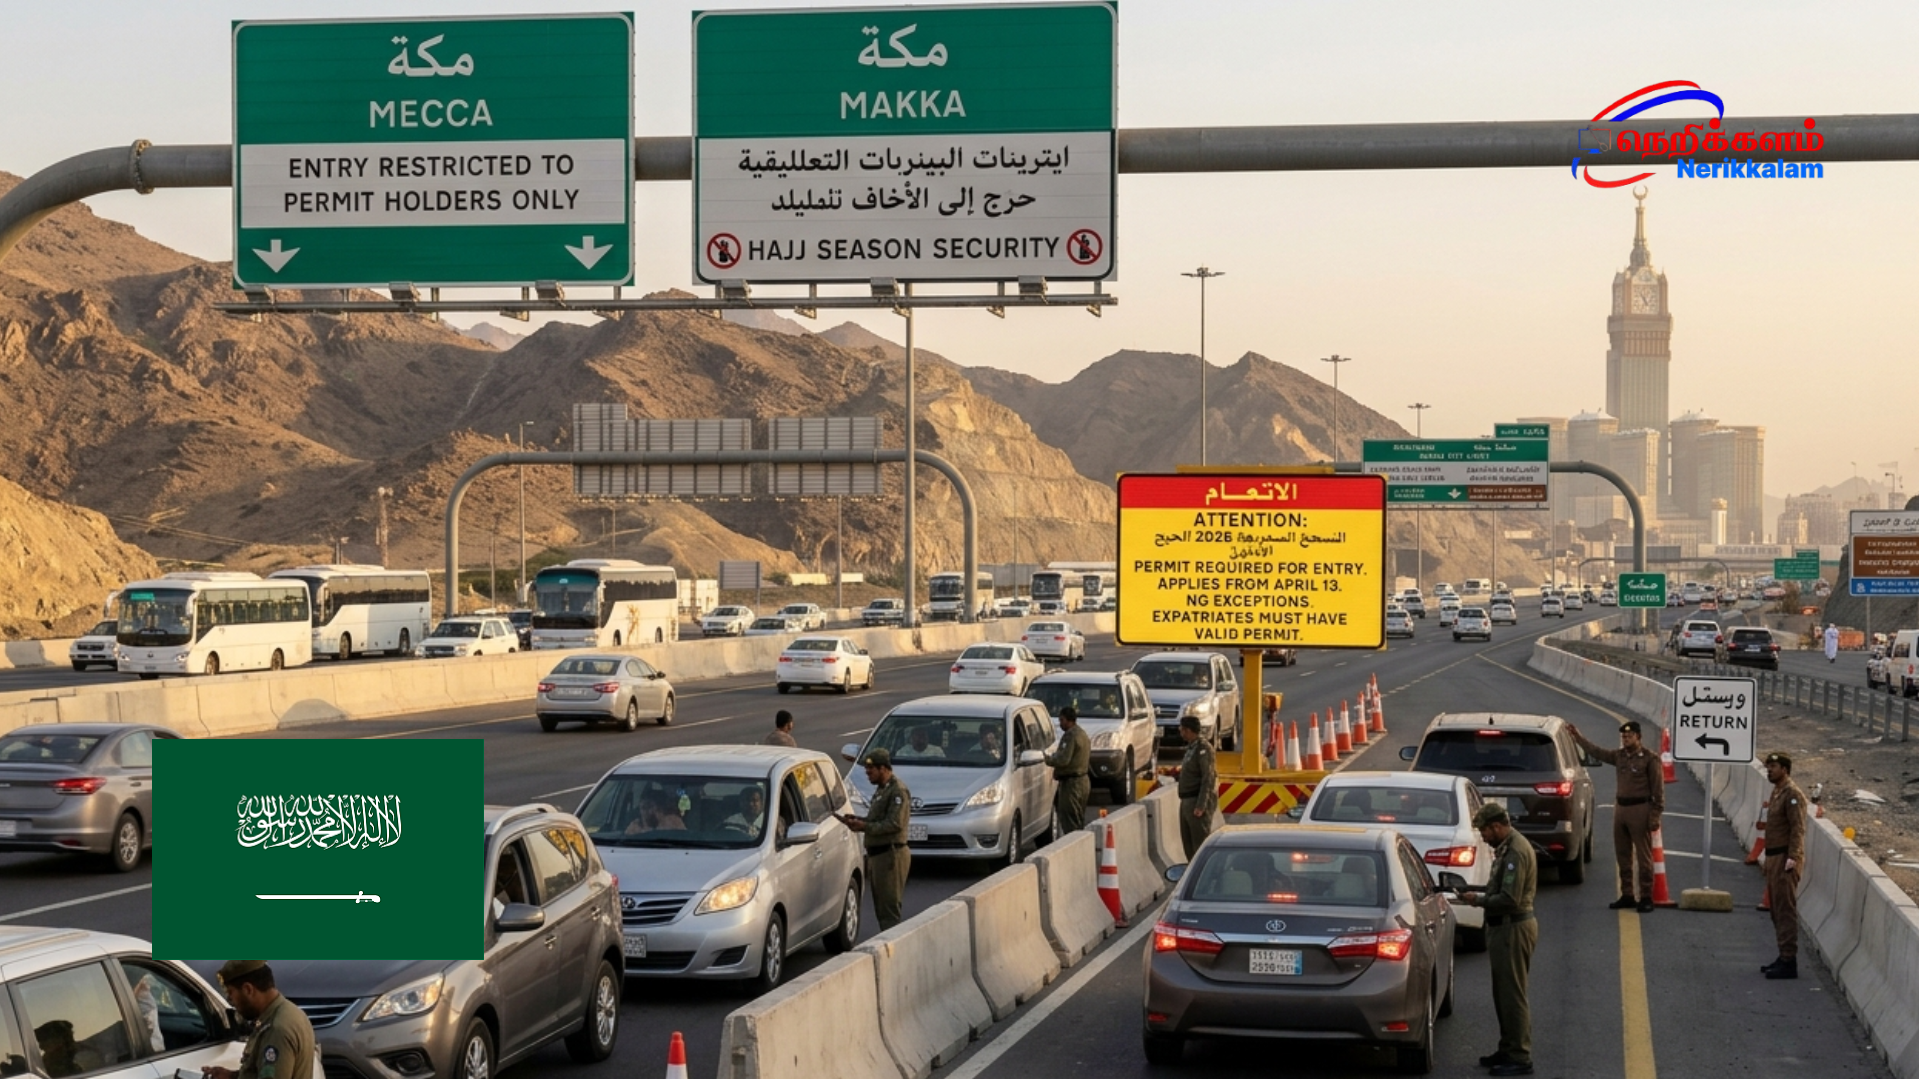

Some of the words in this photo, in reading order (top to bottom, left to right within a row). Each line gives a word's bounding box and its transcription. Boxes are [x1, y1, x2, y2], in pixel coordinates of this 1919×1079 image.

[387, 33, 474, 77] مكة
[857, 23, 948, 68] مكة
[369, 99, 493, 128] MECCA
[840, 89, 966, 119] MAKKA
[289, 157, 369, 178] ENTRY
[379, 155, 532, 177] RESTRICTED
[541, 154, 574, 175] TO
[284, 191, 374, 213] PERMIT
[385, 189, 501, 212] HOLDERS
[512, 188, 579, 210] ONLY
[938, 186, 974, 216] إلى
[983, 192, 1037, 218] حرج
[748, 239, 806, 261] HAJJ
[817, 238, 921, 261] SEASON
[933, 236, 1060, 259] SECURITY
[1193, 512, 1308, 527] ATTENTION:
[1134, 560, 1191, 573] PERMIT
[1278, 562, 1308, 575] FOR
[1313, 563, 1367, 576] ENTRY.
[1157, 577, 1221, 590] APPLIES
[1273, 579, 1318, 591] APRIL
[1322, 580, 1342, 592] 13.
[1152, 610, 1254, 624] EXPATRIATES
[1259, 612, 1303, 624] MUST
[1306, 613, 1348, 626] HAVE
[1194, 627, 1239, 640] VALID
[1679, 714, 1748, 730] RETURN
